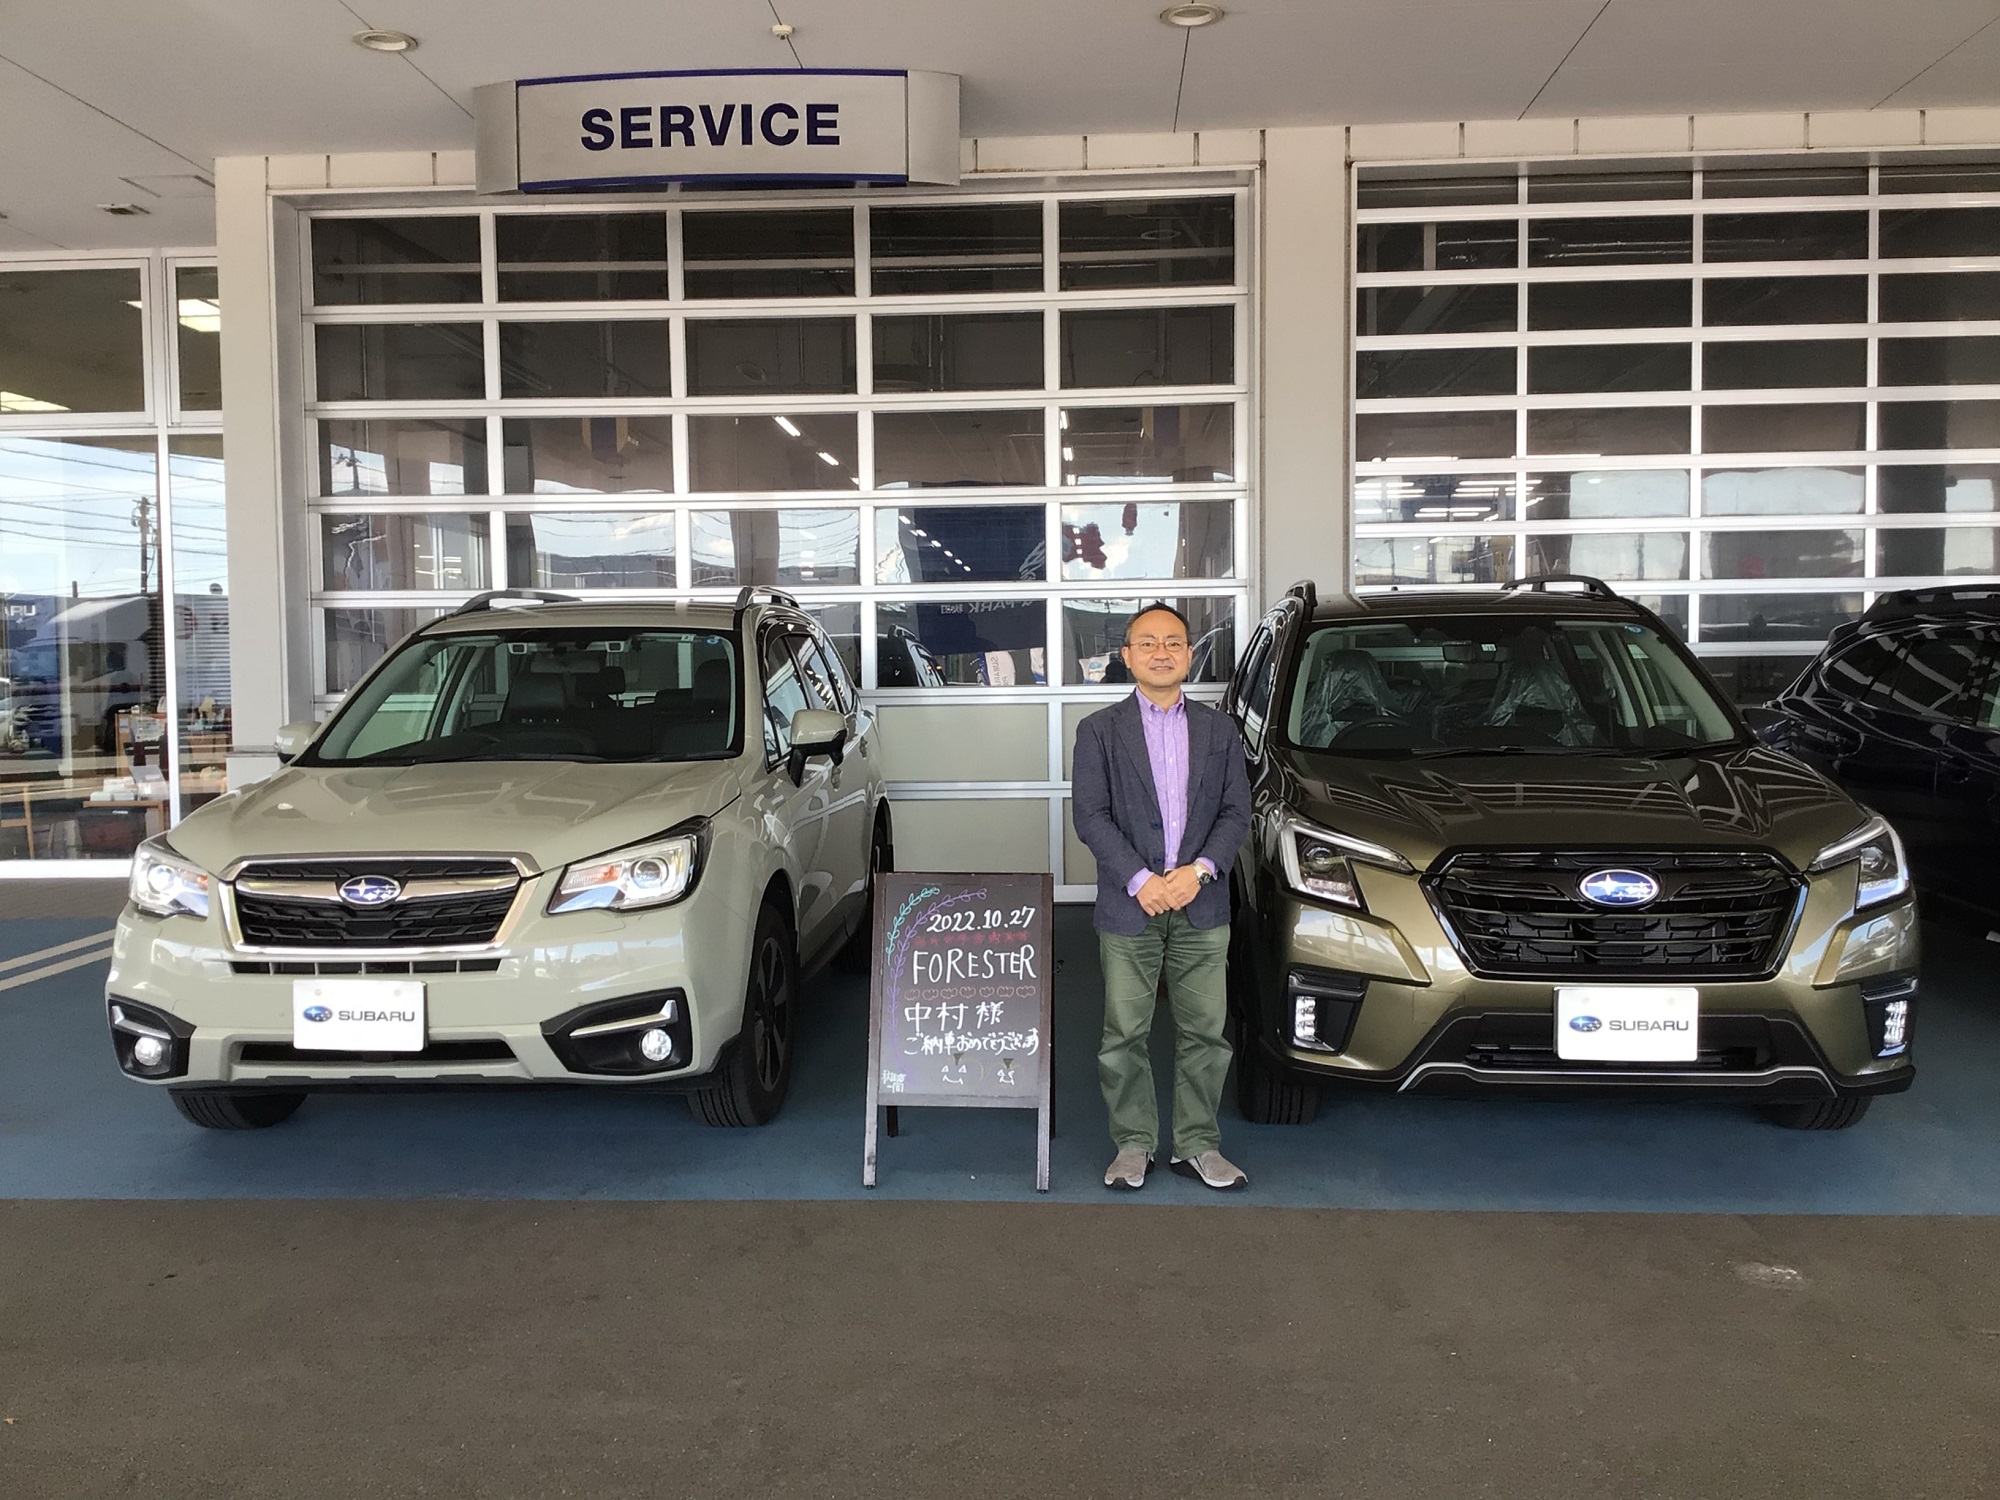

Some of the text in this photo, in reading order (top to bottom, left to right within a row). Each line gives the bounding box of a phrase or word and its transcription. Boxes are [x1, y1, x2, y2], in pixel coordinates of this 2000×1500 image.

[580, 103, 840, 151] SERVICE
[926, 906, 1036, 932] 2022.10.27
[913, 944, 1037, 985] FORESTER
[338, 1010, 416, 1022] SUBARU
[1608, 1020, 1690, 1031] SUBARU
